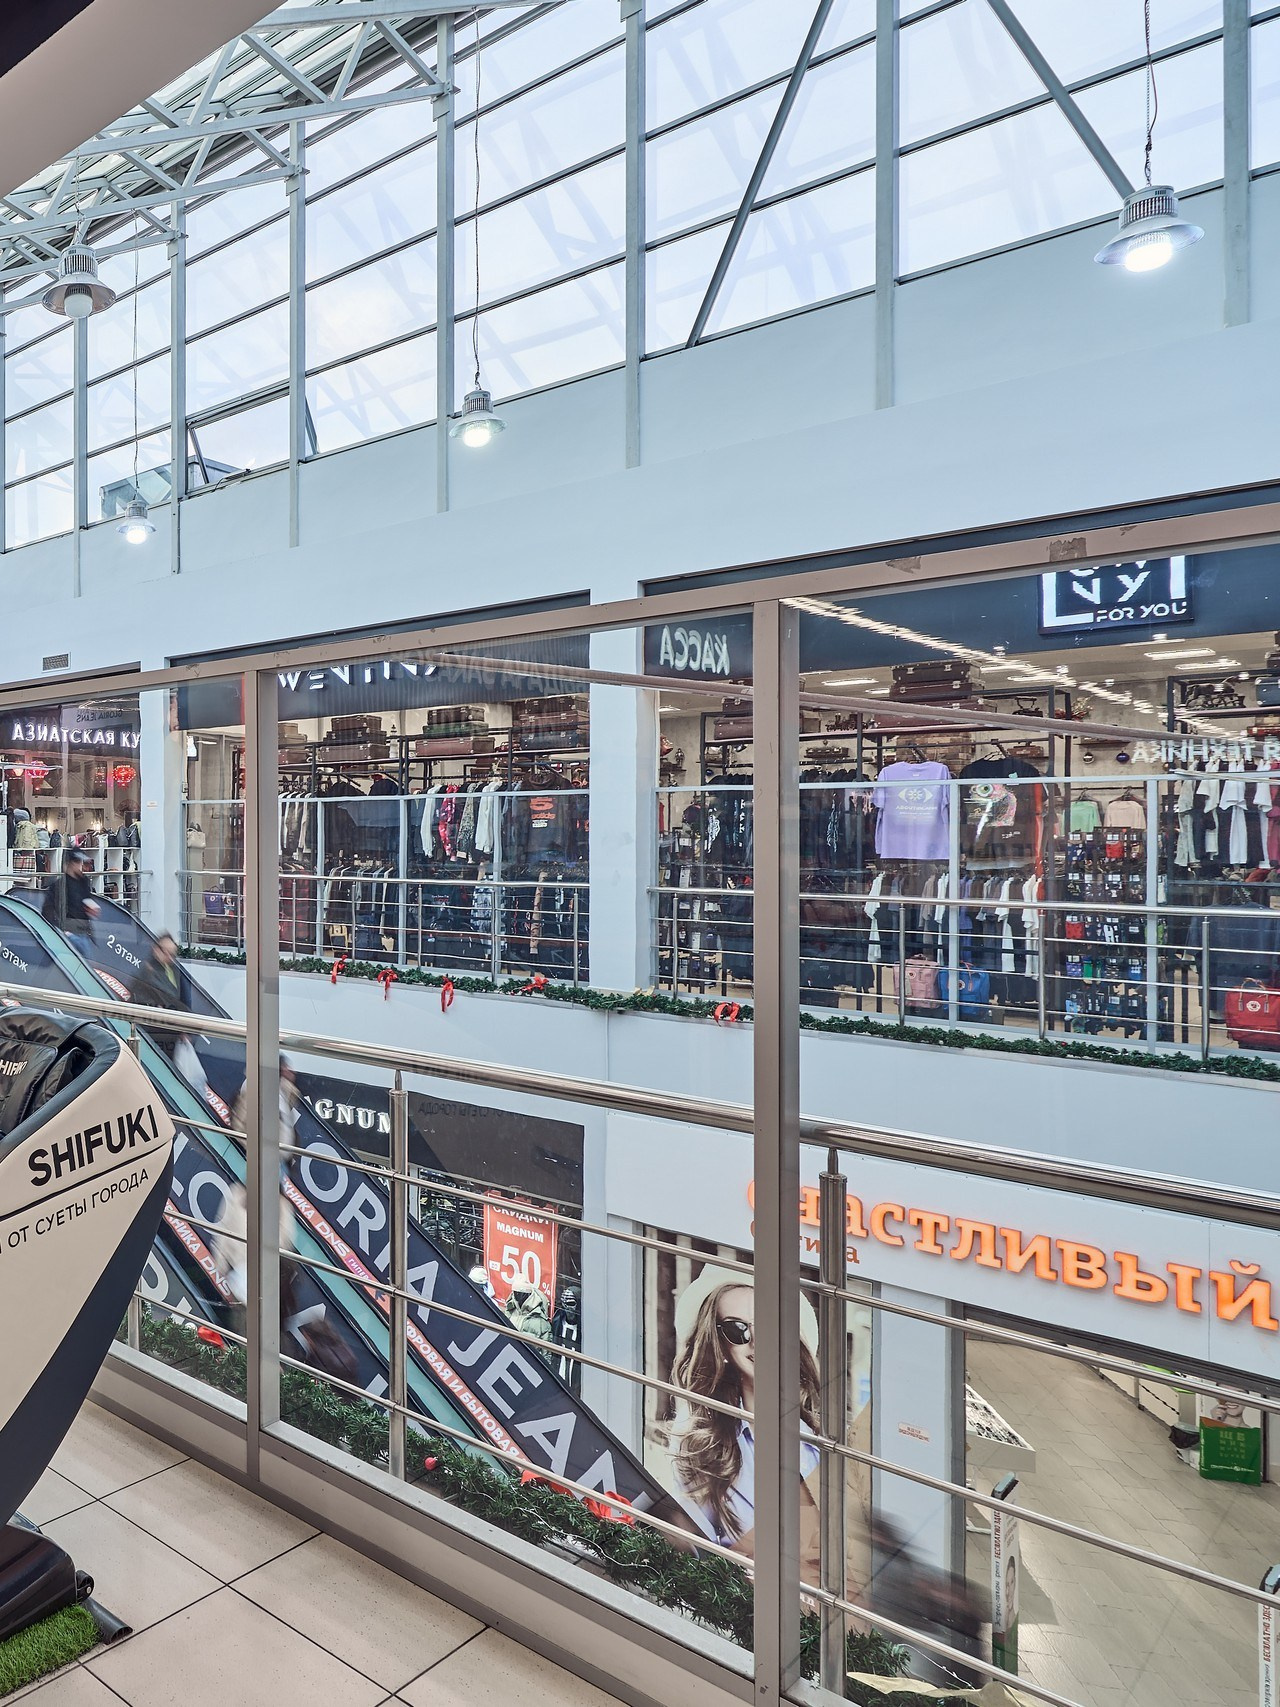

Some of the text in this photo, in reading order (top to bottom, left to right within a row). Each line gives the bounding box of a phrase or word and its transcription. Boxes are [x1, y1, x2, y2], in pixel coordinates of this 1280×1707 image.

[1096, 601, 1187, 623] FOR YOU
[11, 722, 115, 746] АЗИАТСКАЯ
[2, 947, 28, 973] этаж
[106, 934, 142, 969] 2 этаж
[205, 1091, 229, 1117] ОВАЯ
[304, 1095, 391, 1134] GNUM
[28, 1104, 159, 1187] SHIFUKI
[7, 1226, 29, 1248] ОТ
[35, 1198, 87, 1235] СУЕТЫ
[91, 1167, 149, 1208] ГОРОДА
[282, 1182, 315, 1219] ХНИКА
[315, 1221, 350, 1258] DNS
[496, 1221, 544, 1243] MAGNUM
[748, 1180, 1280, 1332] частливый
[200, 1255, 232, 1297] DNS
[407, 1323, 520, 1457] ФРОВАЯ И БЫТОВАЯ
[993, 1510, 1001, 1525] ЗДЕС
[993, 1525, 1001, 1560] БЕСПЛАТНО
[1262, 1604, 1272, 1622] ЗДЕС
[1262, 1622, 1271, 1663] БЕСПЛАТНО
